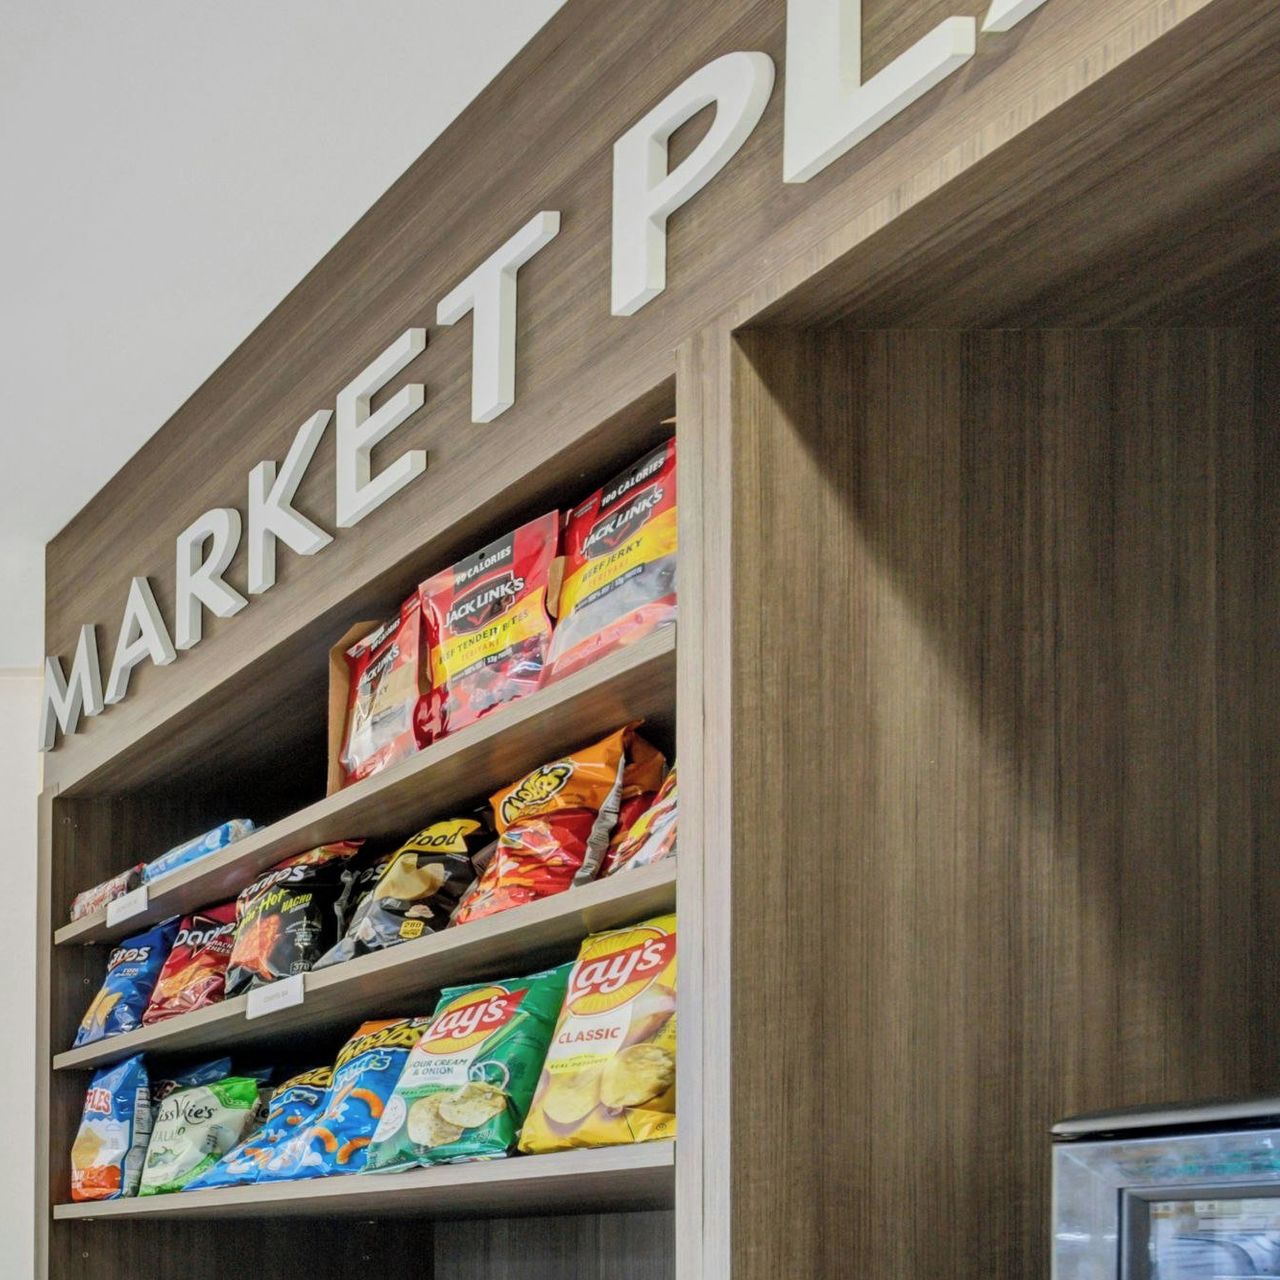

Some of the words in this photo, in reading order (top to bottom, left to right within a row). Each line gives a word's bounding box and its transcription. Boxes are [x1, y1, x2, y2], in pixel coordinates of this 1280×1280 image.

[39, 210, 561, 752] MARKET
[612, 0, 1042, 317] PL
[617, 456, 665, 496] CALORIES
[580, 519, 616, 553] JACK
[614, 488, 664, 529] LINK'S
[466, 545, 512, 579] CALORIES
[605, 537, 643, 568] JERKY
[444, 603, 478, 629] JACK
[476, 577, 525, 610] LINK'S
[567, 937, 667, 1003] Lay's
[421, 995, 507, 1045] Lay's
[558, 1025, 622, 1045] CLASSIC
[422, 1066, 454, 1076] ONION
[435, 1058, 468, 1067] CREAM
